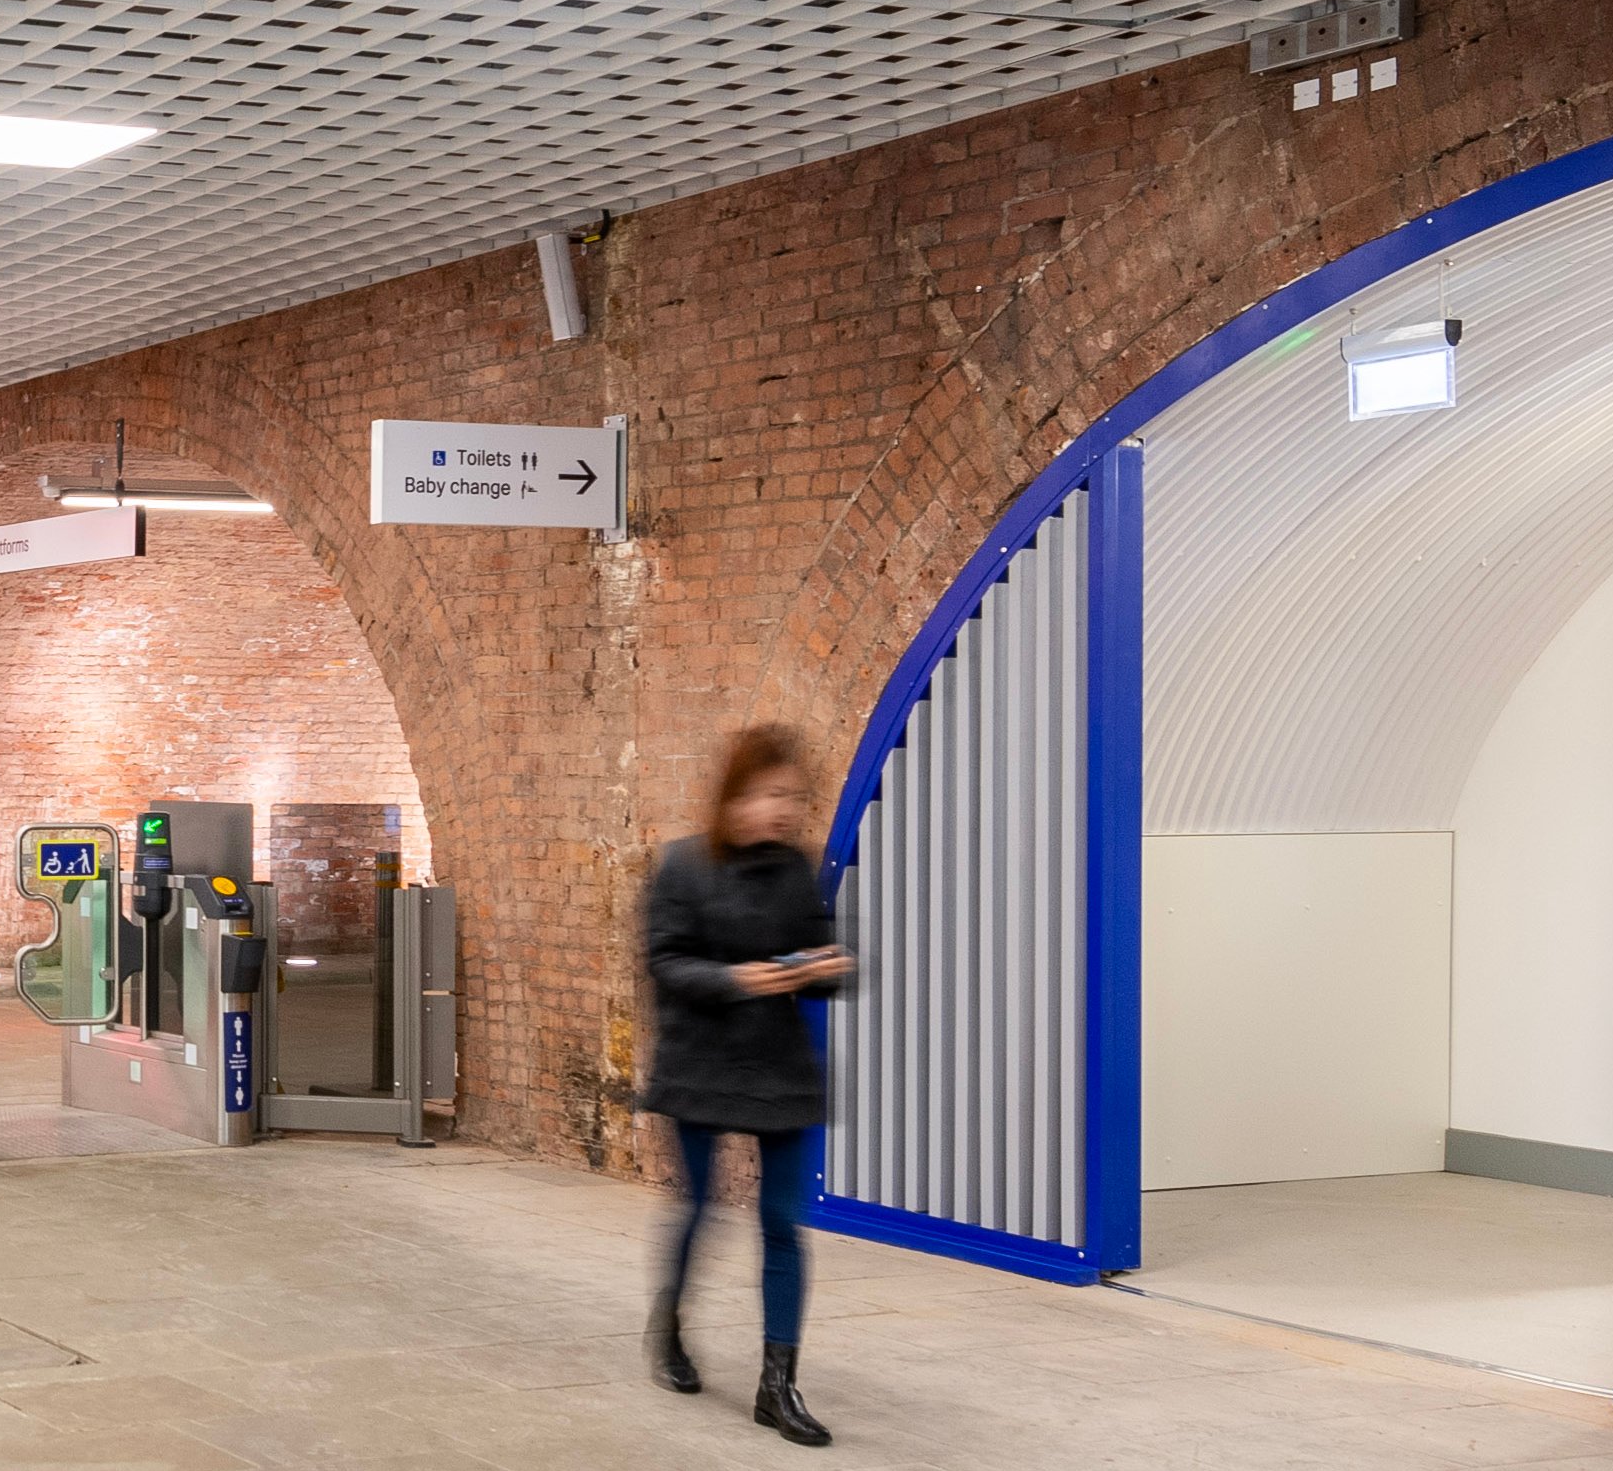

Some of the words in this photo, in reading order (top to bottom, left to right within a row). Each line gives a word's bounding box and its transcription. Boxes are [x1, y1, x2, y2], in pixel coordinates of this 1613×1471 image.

[456, 449, 511, 467] Toilets
[405, 477, 446, 497] Baby
[450, 478, 511, 499] change
